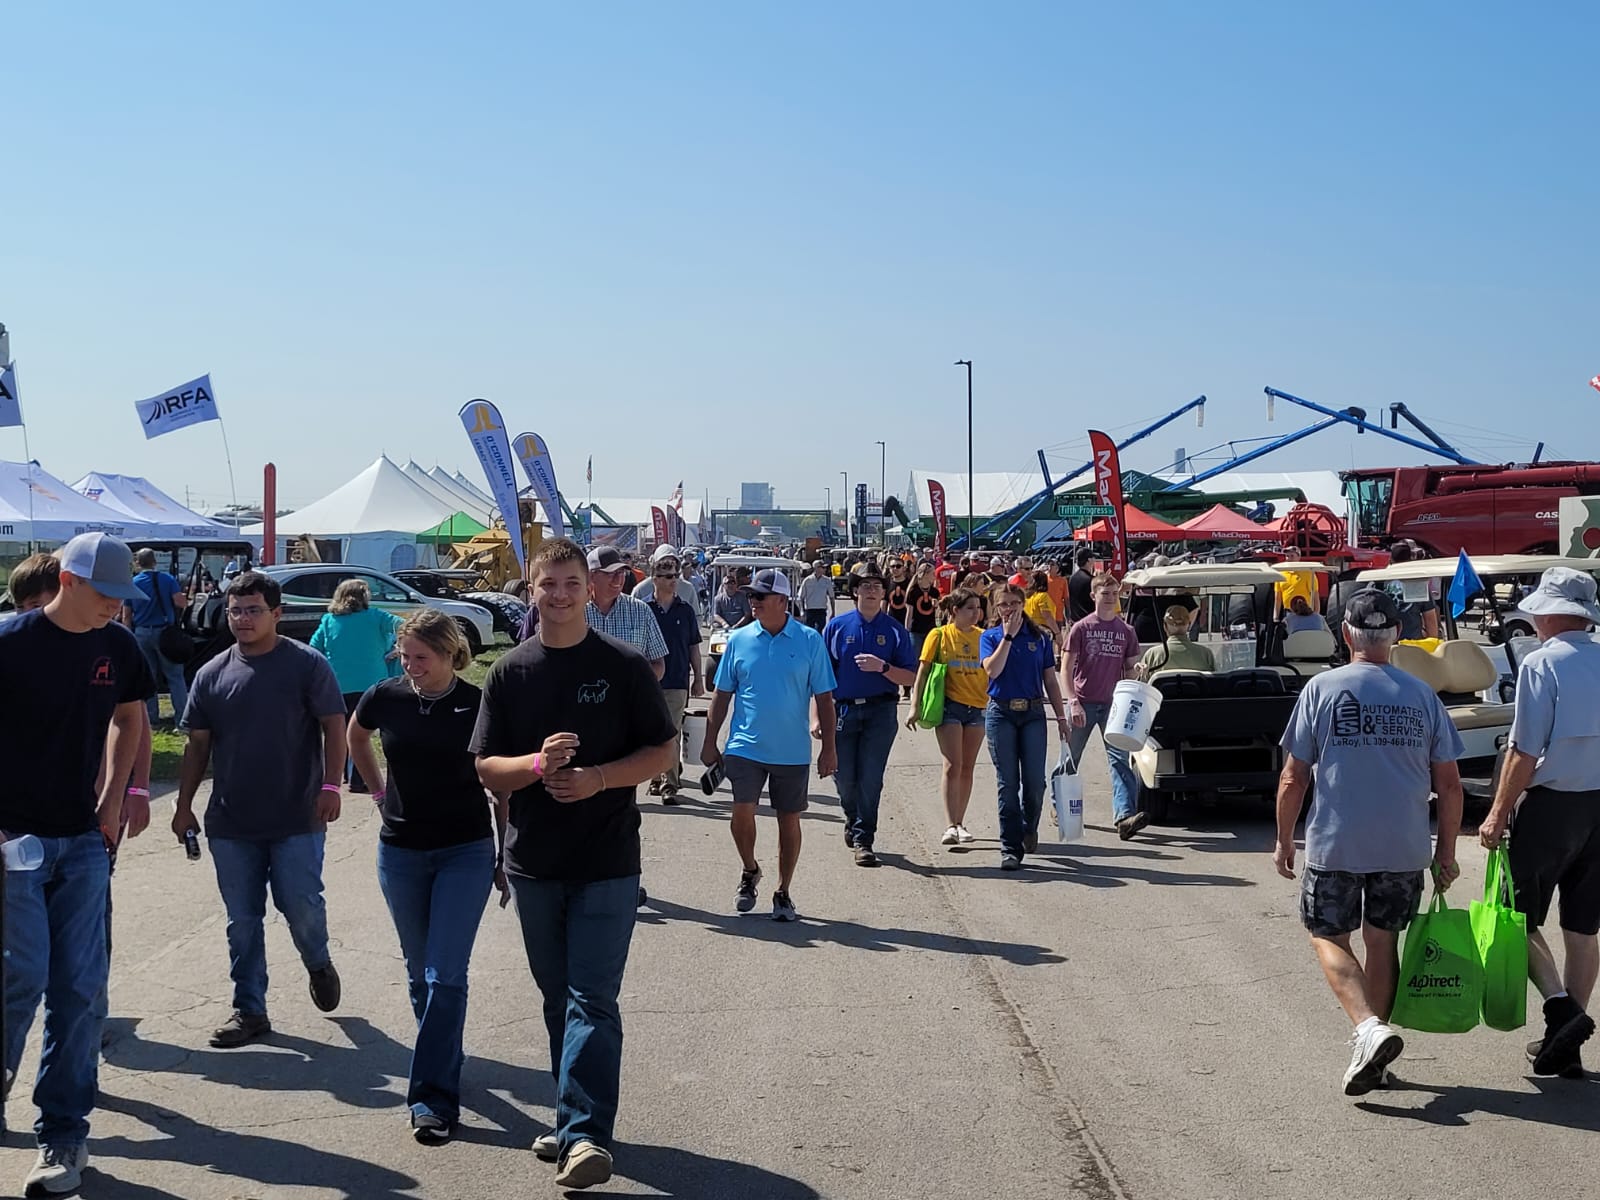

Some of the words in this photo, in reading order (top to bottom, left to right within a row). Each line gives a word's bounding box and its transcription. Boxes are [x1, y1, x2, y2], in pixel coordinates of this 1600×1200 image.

[164, 386, 211, 413] RFA
[486, 435, 513, 489] O'CONNELL
[1061, 504, 1077, 515] Fifth
[1079, 504, 1108, 516] Progress
[1535, 511, 1559, 519] CAS
[1126, 531, 1158, 539] acDon
[1211, 531, 1251, 539] MacDon
[1087, 630, 1106, 639] BLAME
[1115, 632, 1125, 641] ALL
[1362, 704, 1422, 718] AUTOMATED
[1362, 714, 1377, 735] &
[1375, 714, 1425, 728] ELECTRIC
[1382, 725, 1424, 738] SERVICE
